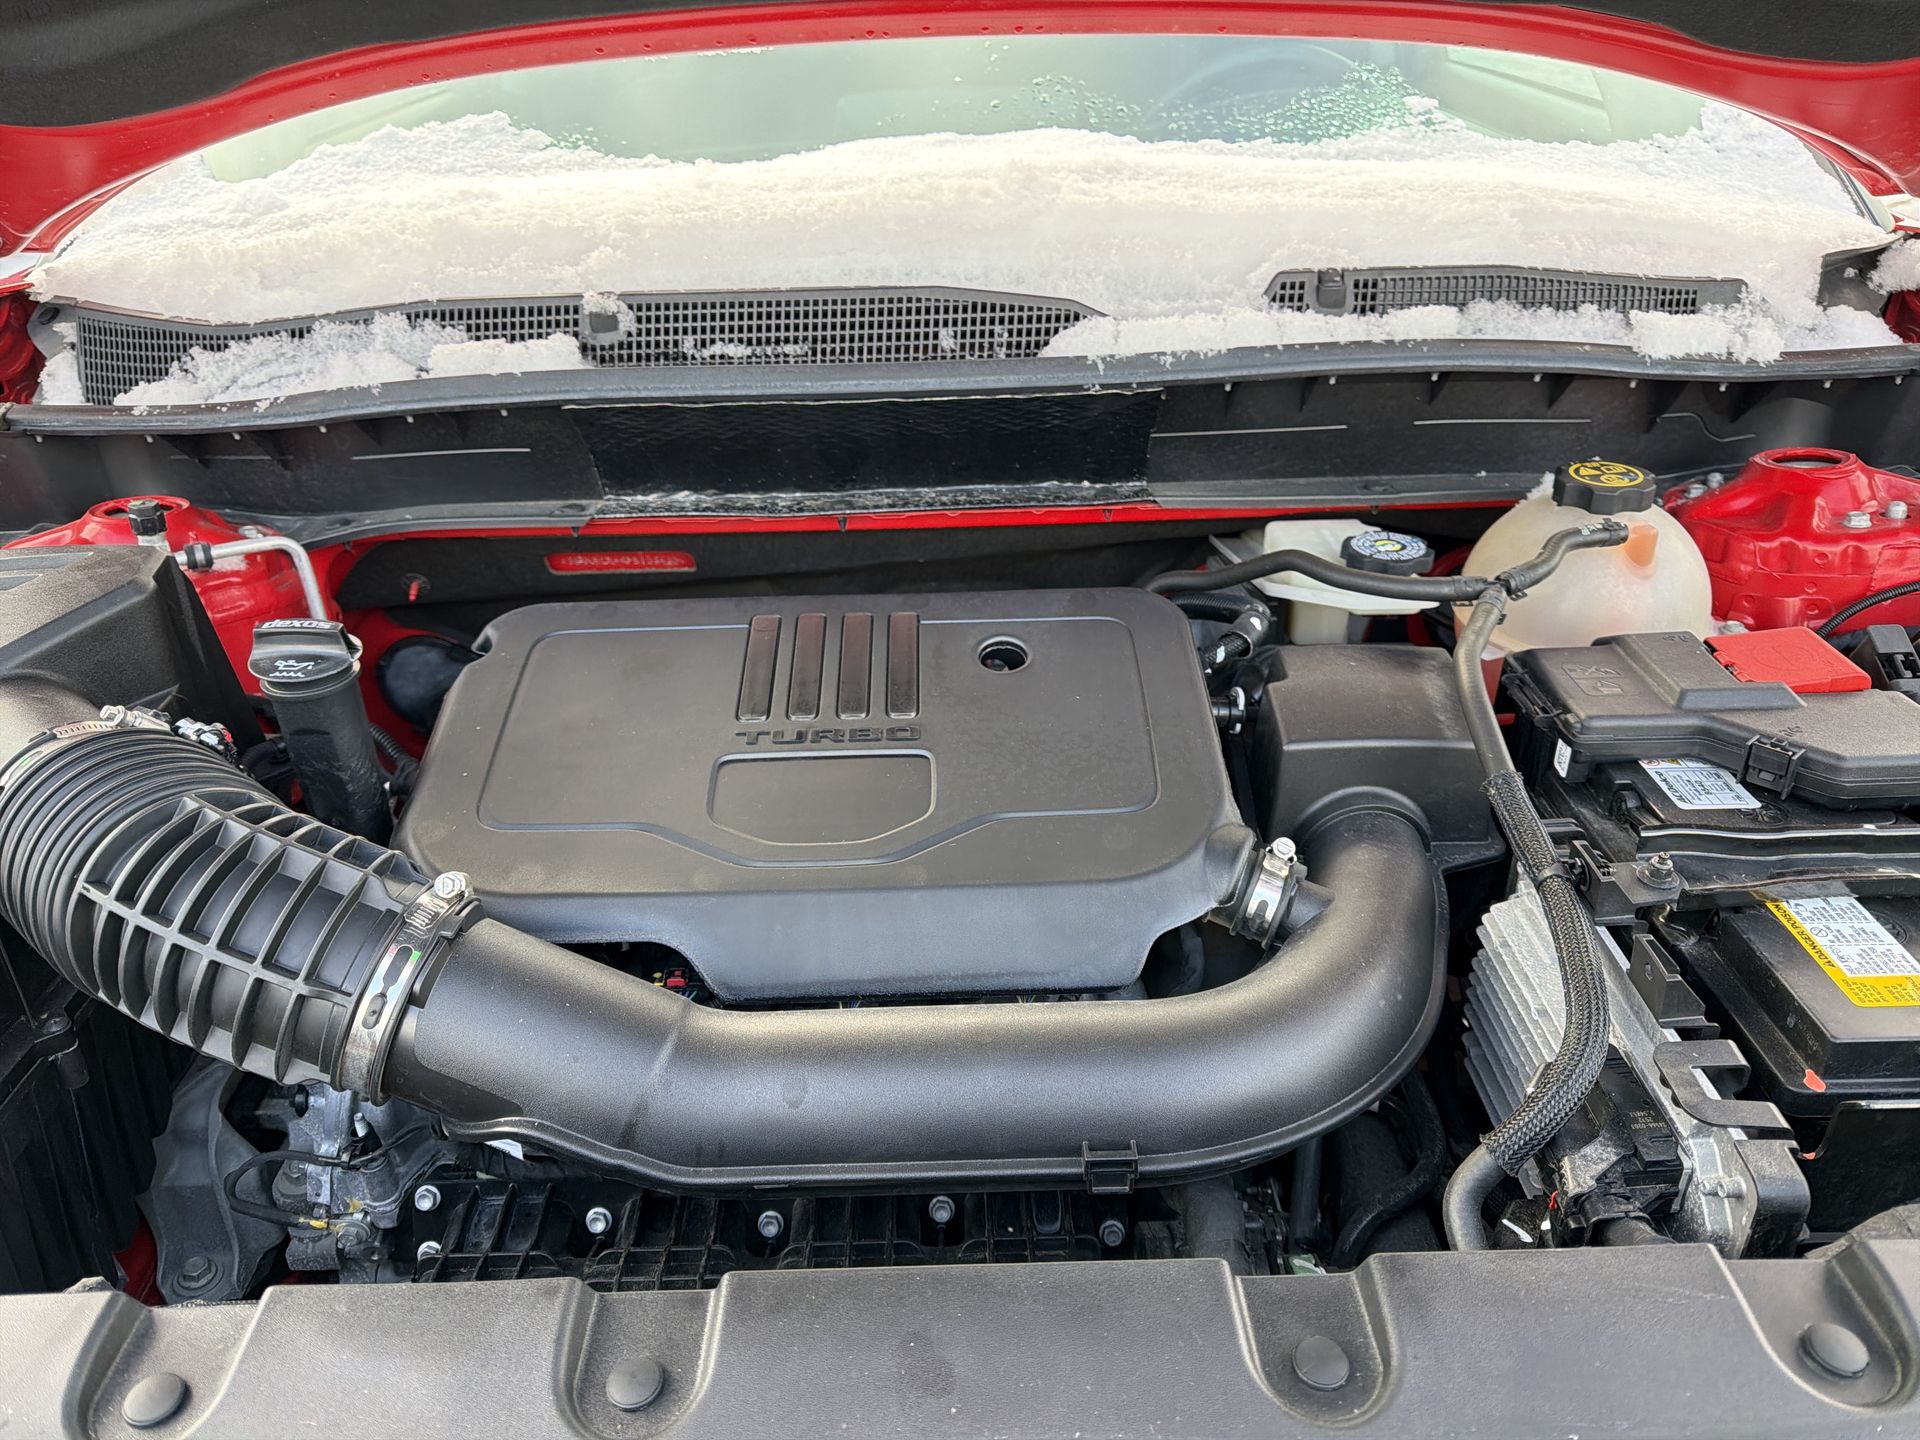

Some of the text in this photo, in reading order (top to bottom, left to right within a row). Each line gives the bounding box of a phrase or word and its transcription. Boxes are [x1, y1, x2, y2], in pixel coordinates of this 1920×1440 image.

[262, 619, 334, 629] dexos
[735, 725, 922, 746] TURBO
[1655, 771, 1689, 803] ACDelco
[1772, 903, 1829, 961] DANGER POISON
